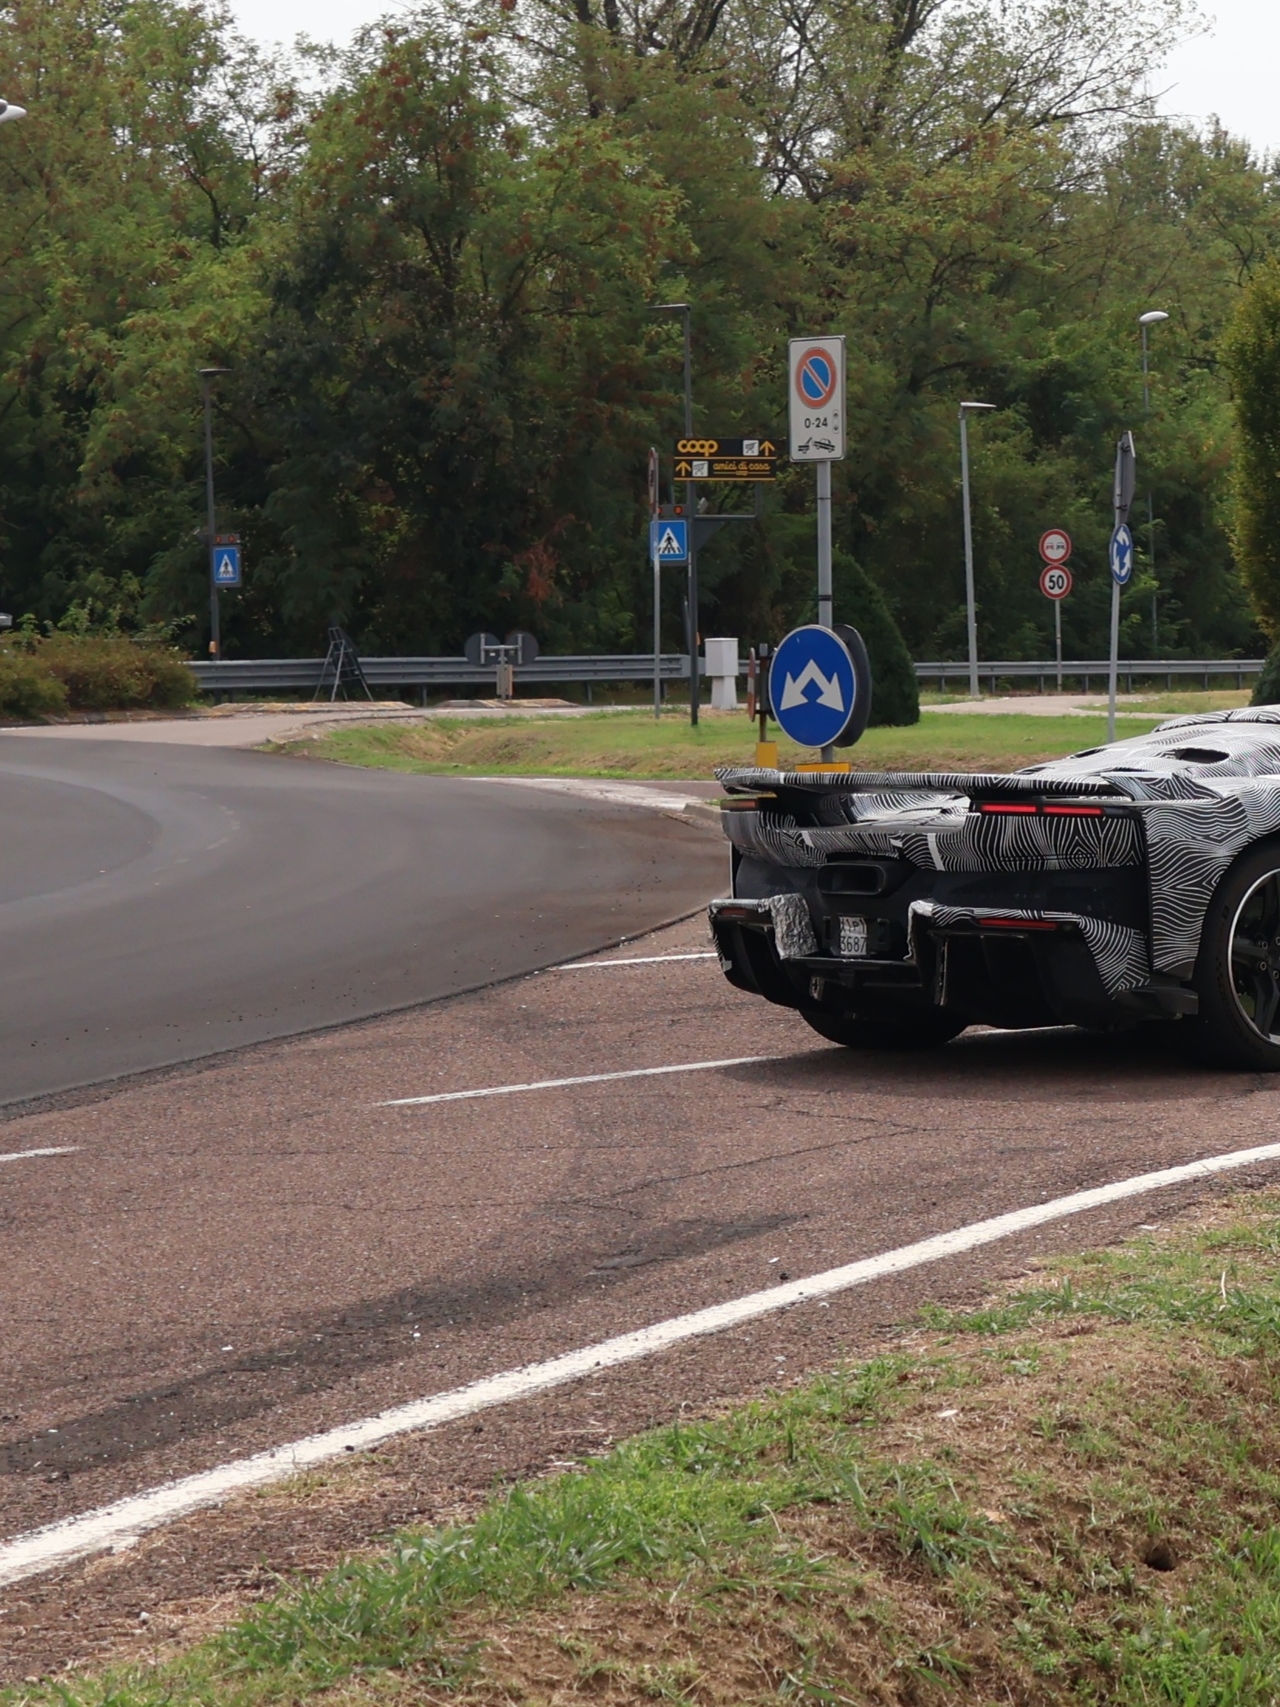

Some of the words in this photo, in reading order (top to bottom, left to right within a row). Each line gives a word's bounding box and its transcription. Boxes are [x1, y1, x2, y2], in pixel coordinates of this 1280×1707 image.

[804, 418, 828, 428] 0-24
[677, 440, 718, 456] coop
[738, 461, 747, 470] di
[1048, 574, 1065, 590] 50
